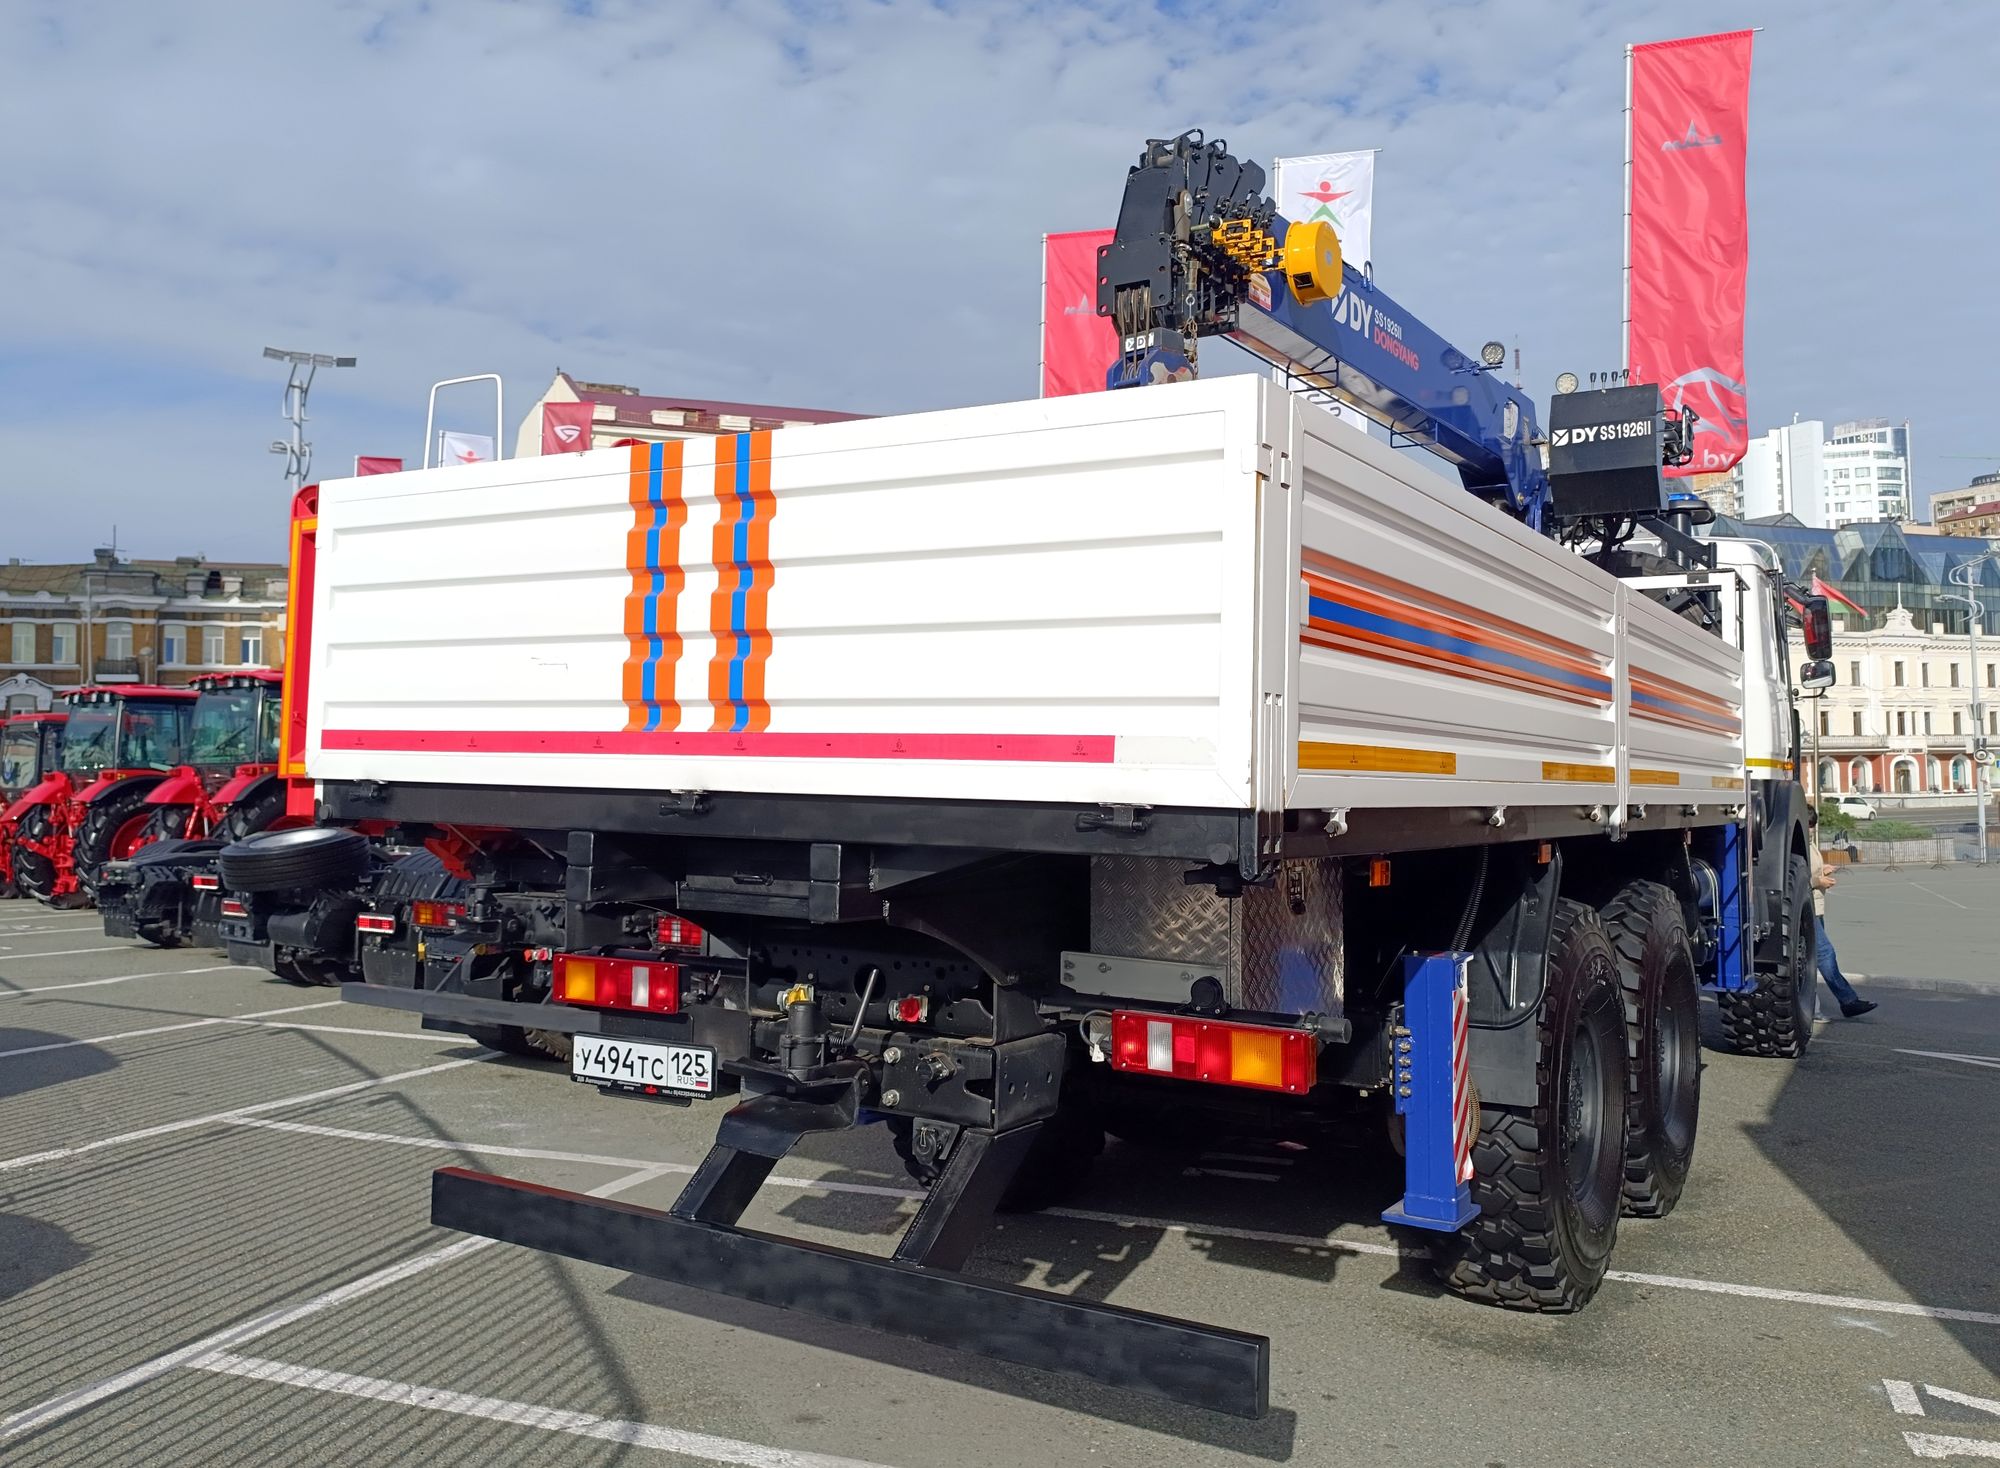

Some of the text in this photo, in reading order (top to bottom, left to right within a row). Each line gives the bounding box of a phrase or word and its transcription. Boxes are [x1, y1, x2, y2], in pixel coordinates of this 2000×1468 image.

[1350, 291, 1373, 339] DY
[1374, 326, 1419, 371] DONGYANG
[1572, 421, 1651, 444] DY SS1926II
[671, 1052, 706, 1077] 125
[677, 1075, 695, 1086] RUS
